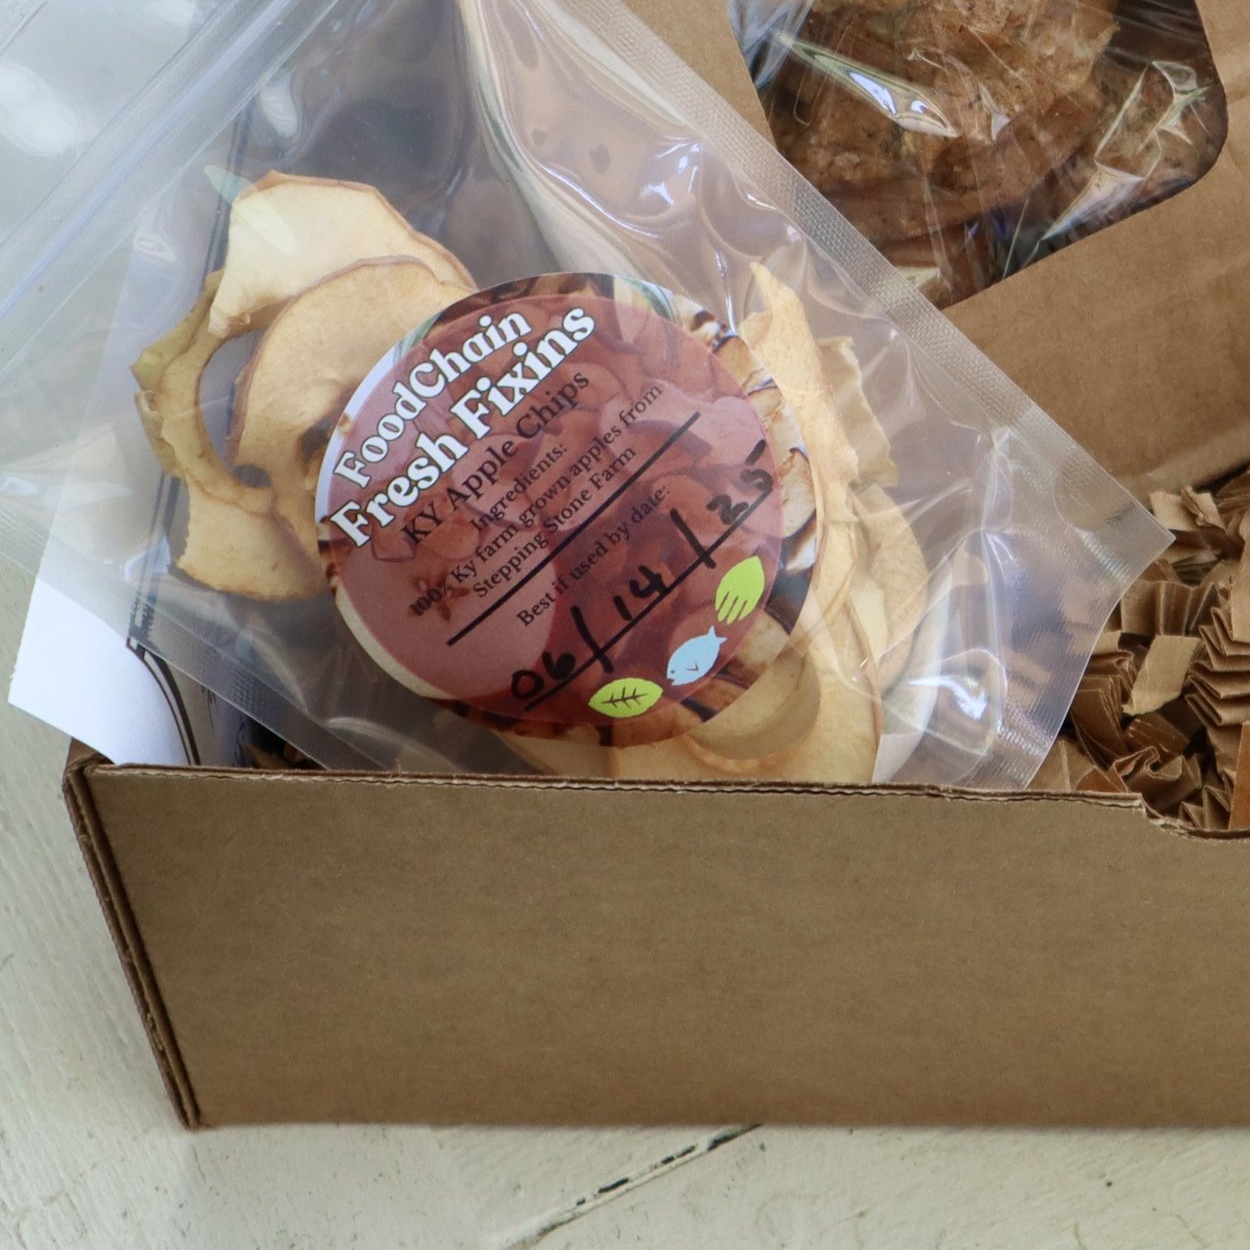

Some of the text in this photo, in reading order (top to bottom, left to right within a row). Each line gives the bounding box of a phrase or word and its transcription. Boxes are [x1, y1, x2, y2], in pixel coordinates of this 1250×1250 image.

[329, 307, 598, 549] Fresh Fixins
[333, 308, 533, 490] FoodChain
[401, 372, 590, 546] KY Apple Chips
[408, 384, 663, 617] 100% Ky farm grown apples from
[470, 442, 568, 532] Ingredients:
[472, 447, 637, 599] Stepping Stone Farm
[516, 485, 672, 627] Best if used by date:
